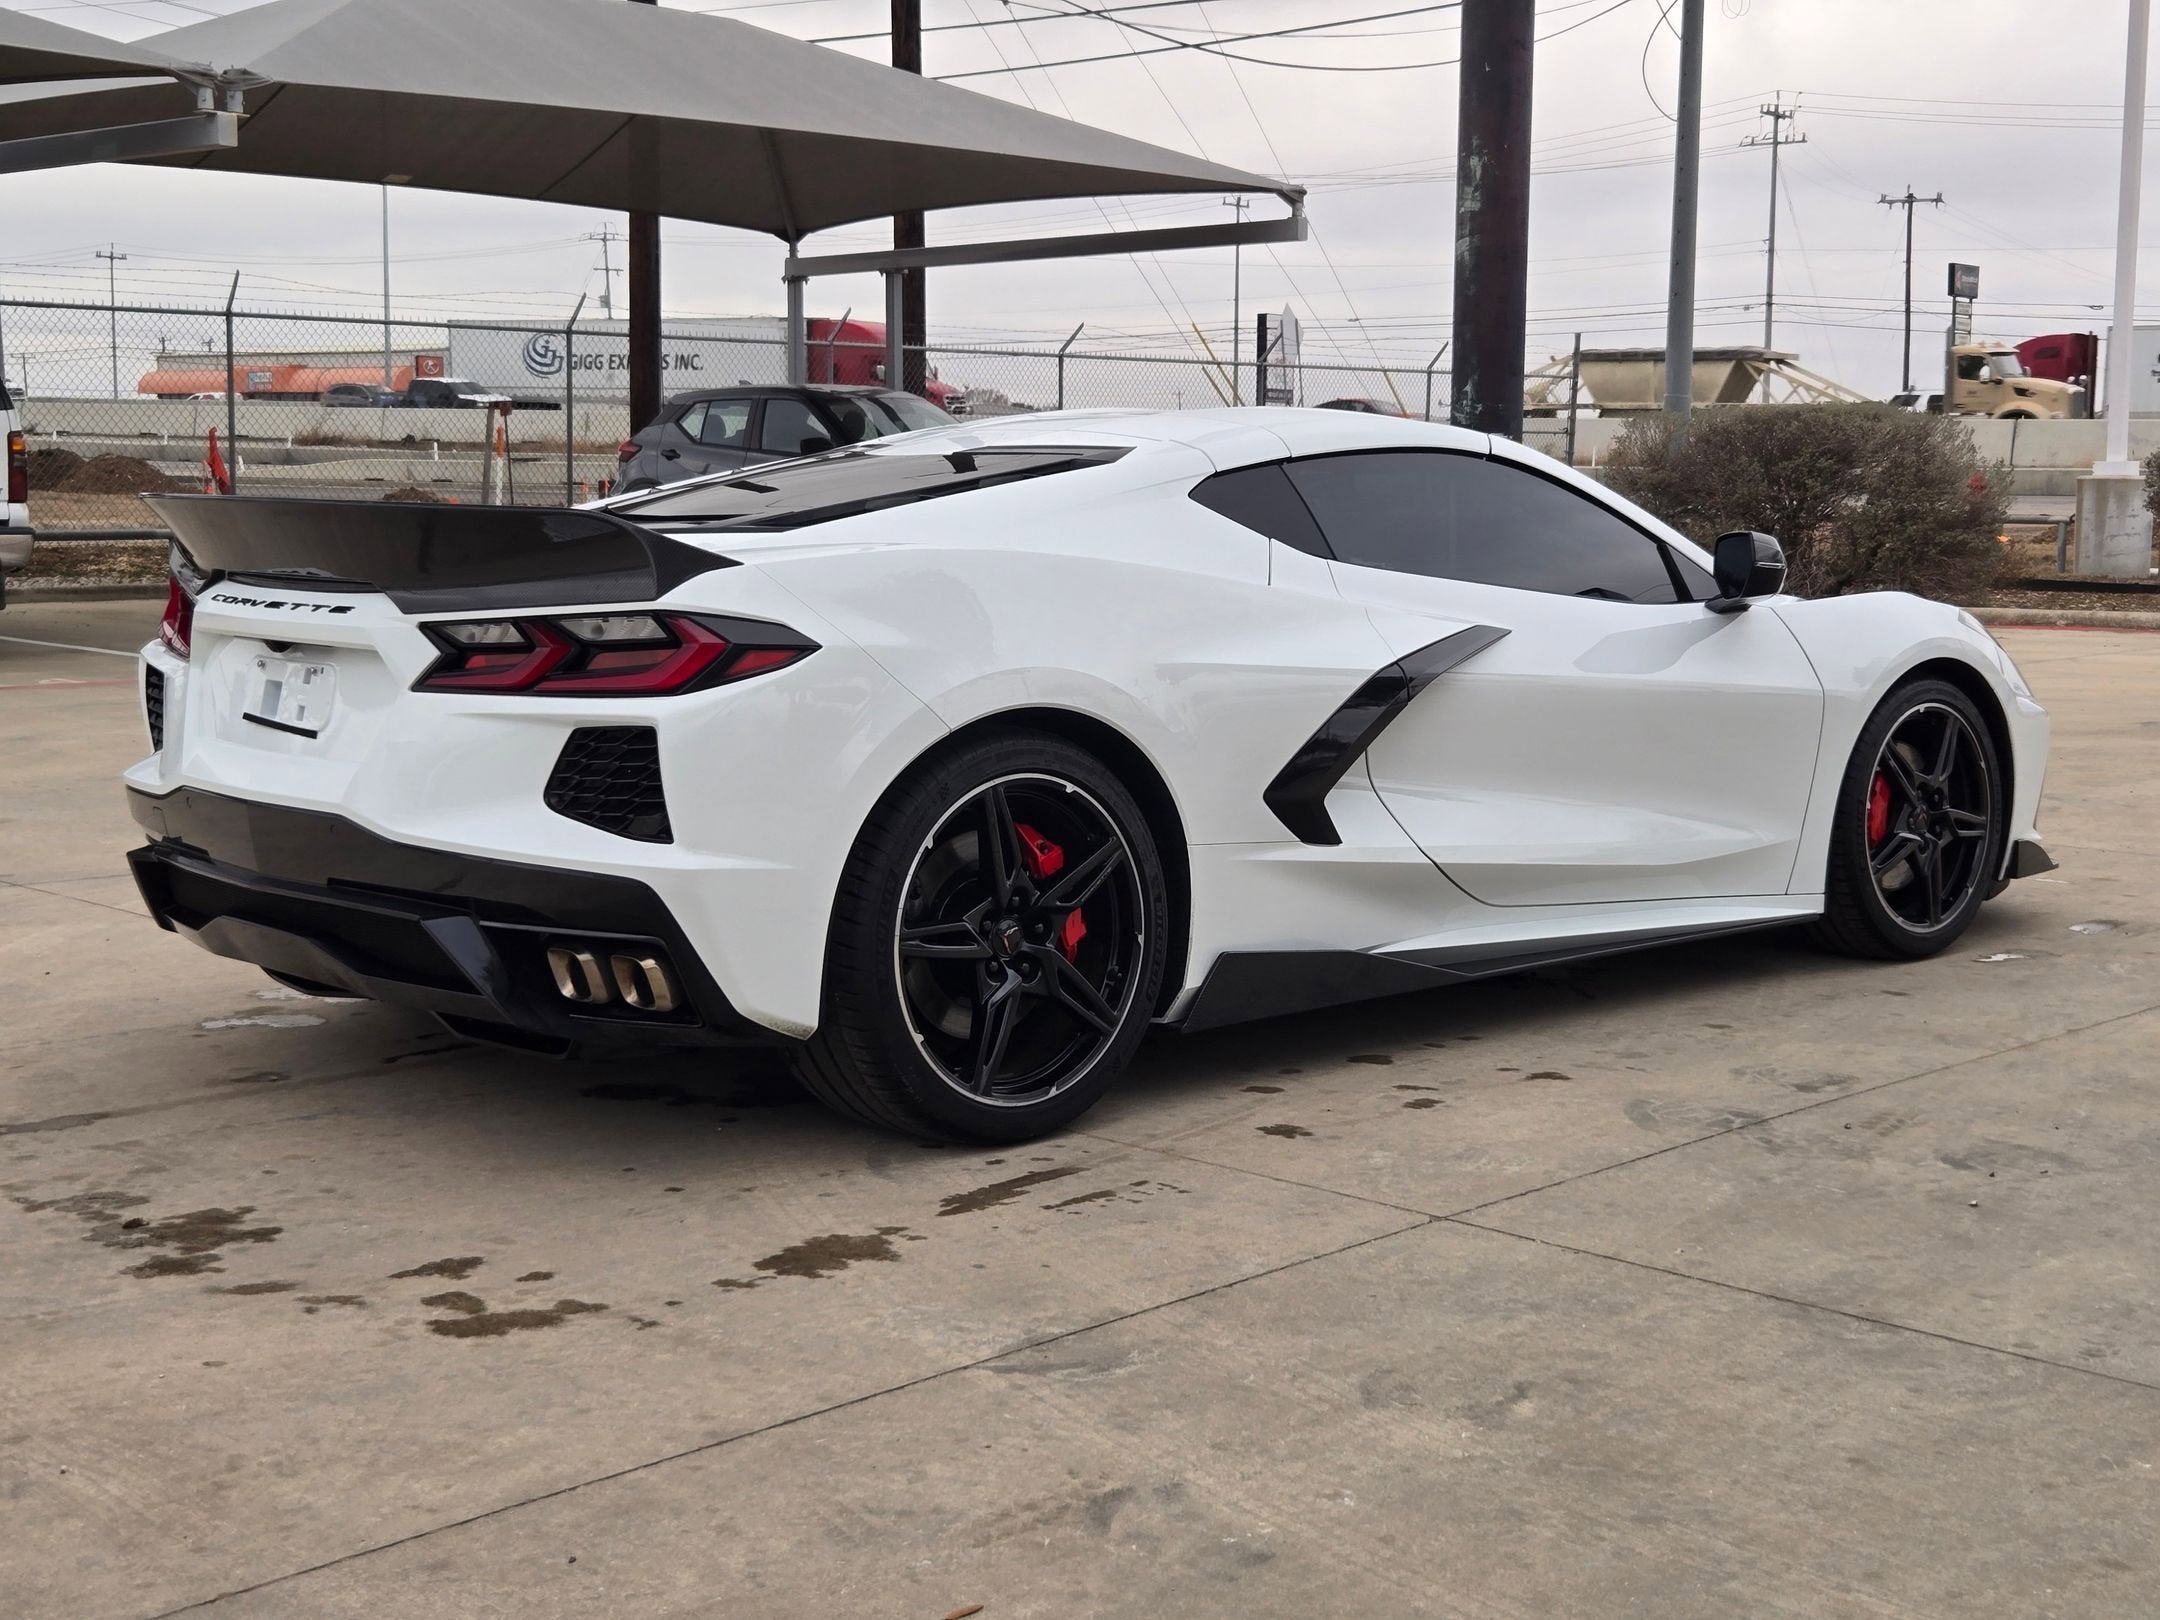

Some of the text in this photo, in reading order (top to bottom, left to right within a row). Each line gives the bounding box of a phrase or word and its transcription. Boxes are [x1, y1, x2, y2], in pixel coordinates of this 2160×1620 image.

[571, 354, 604, 370] GIGG
[674, 354, 704, 370] INC.
[211, 593, 356, 614] CORVETTE
